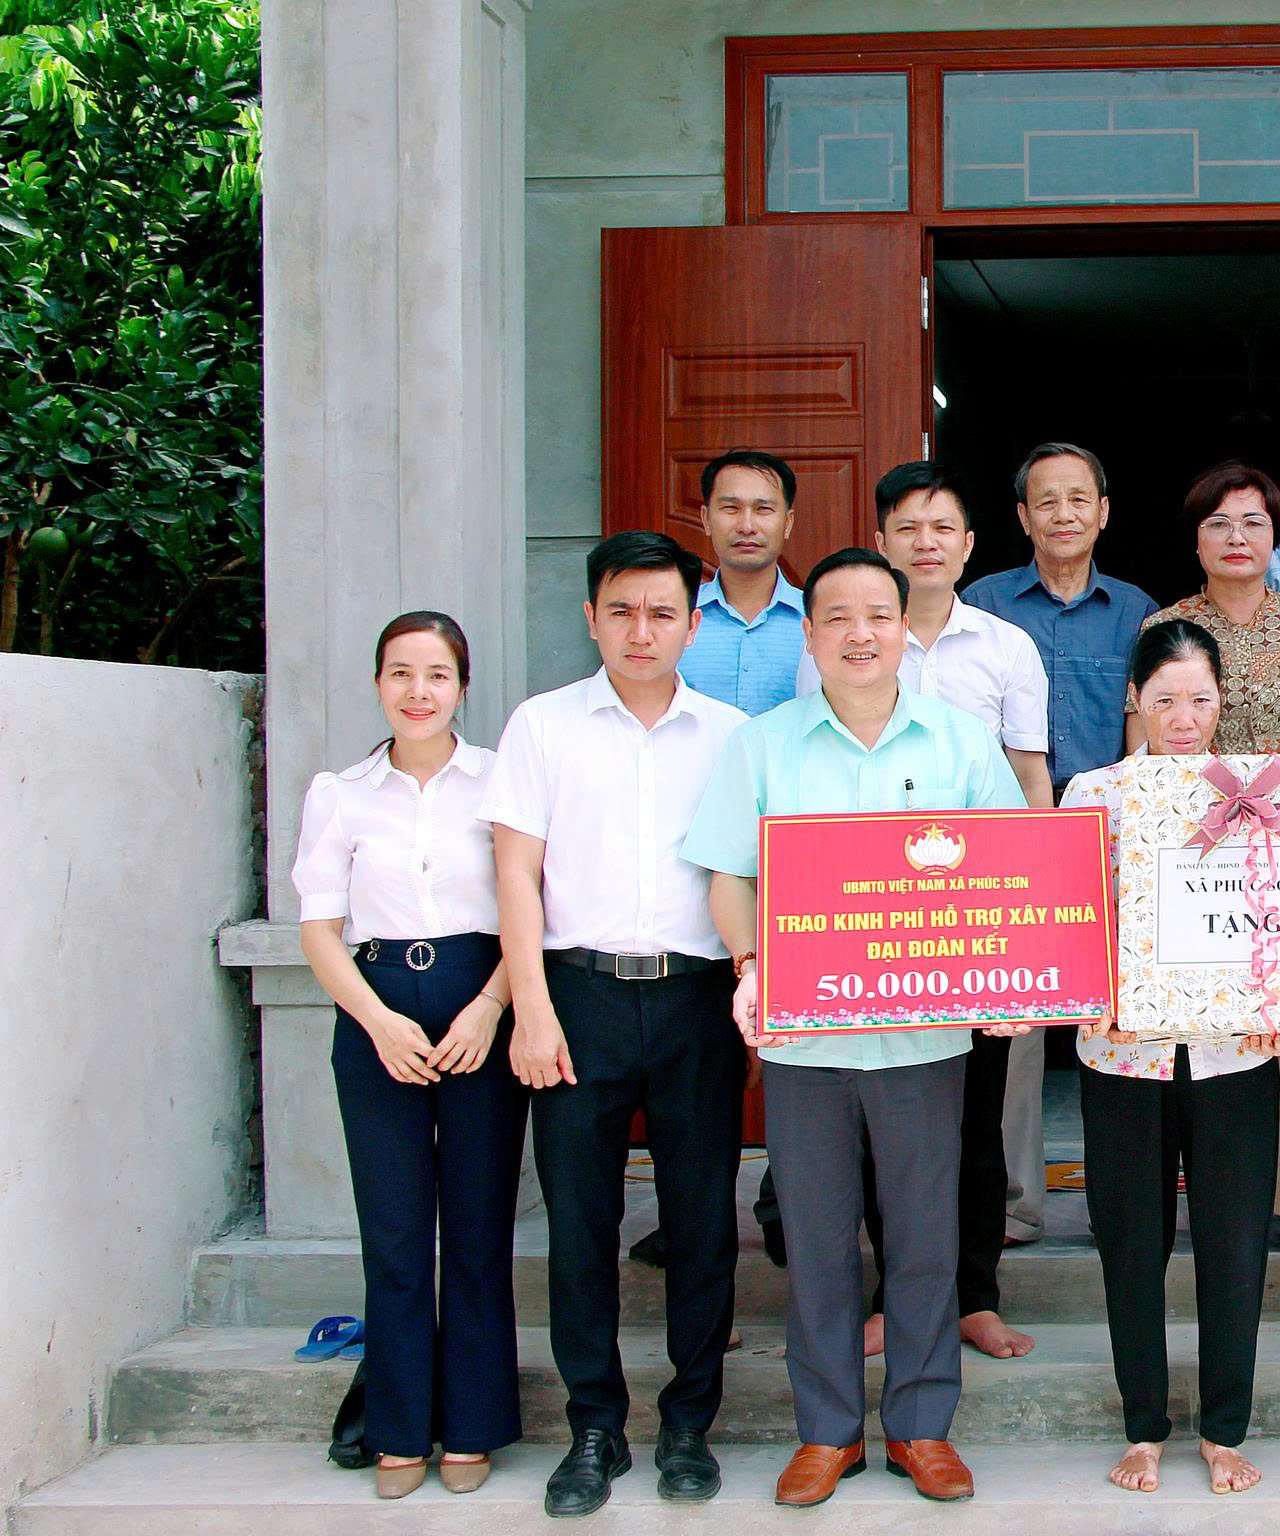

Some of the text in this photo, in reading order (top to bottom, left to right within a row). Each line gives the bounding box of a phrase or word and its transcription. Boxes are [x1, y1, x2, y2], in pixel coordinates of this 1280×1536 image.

[843, 875, 1029, 895] UBMTQ VIỆT NAM XÃ PHÚC SƠN
[1184, 877, 1208, 893] XÃ
[775, 902, 1097, 934] TRAO KINH PHÍ HỖ TRỢ XÂY NHÀ
[1202, 910, 1280, 939] TẶNG
[866, 931, 1009, 963] ĐẠI ĐOÀN KẾT
[816, 966, 1062, 1001] 50.000.000đ
